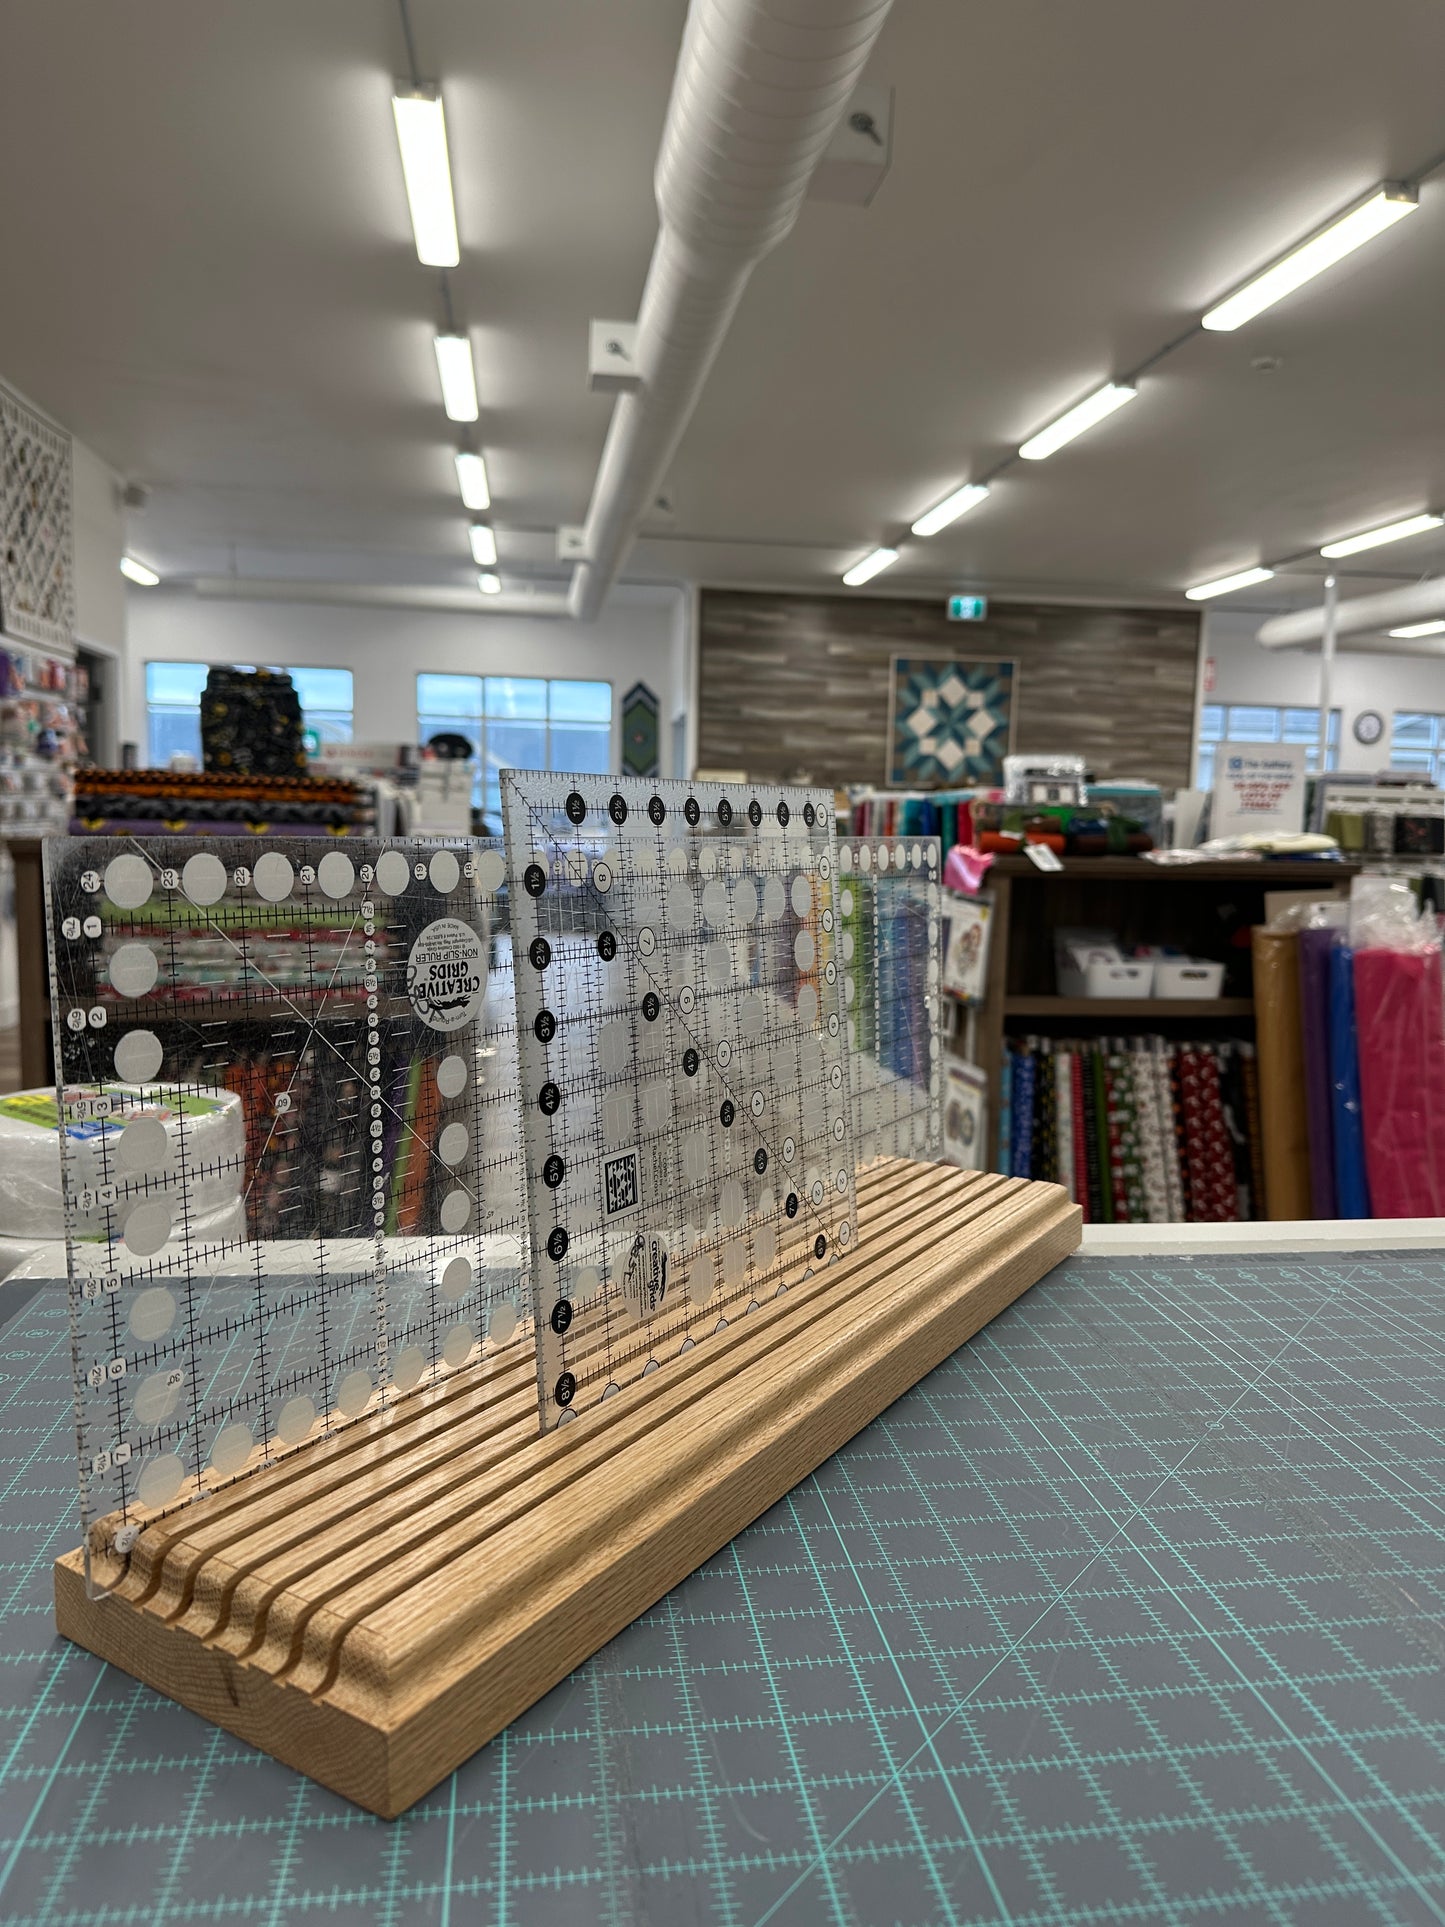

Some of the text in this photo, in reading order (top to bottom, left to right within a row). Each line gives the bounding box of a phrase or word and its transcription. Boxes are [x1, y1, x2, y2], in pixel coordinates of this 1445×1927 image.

[236, 869, 245, 884] 22
[301, 867, 310, 883] 21
[361, 865, 370, 879] 20
[416, 865, 424, 878] 19
[465, 864, 472, 876] 18
[83, 872, 94, 889] 24
[163, 870, 173, 887] 23
[599, 874, 606, 882] 8
[416, 948, 478, 962] NON-SLIP RULER
[429, 961, 468, 980] GRIDS
[419, 976, 480, 999] CREATIVE
[92, 1012, 102, 1021] 2
[97, 1102, 107, 1110] 3
[102, 1190, 112, 1198] 4
[652, 1240, 660, 1290] creative
[107, 1279, 117, 1287] 5
[647, 1280, 657, 1311] grids
[112, 1365, 122, 1374] 6
